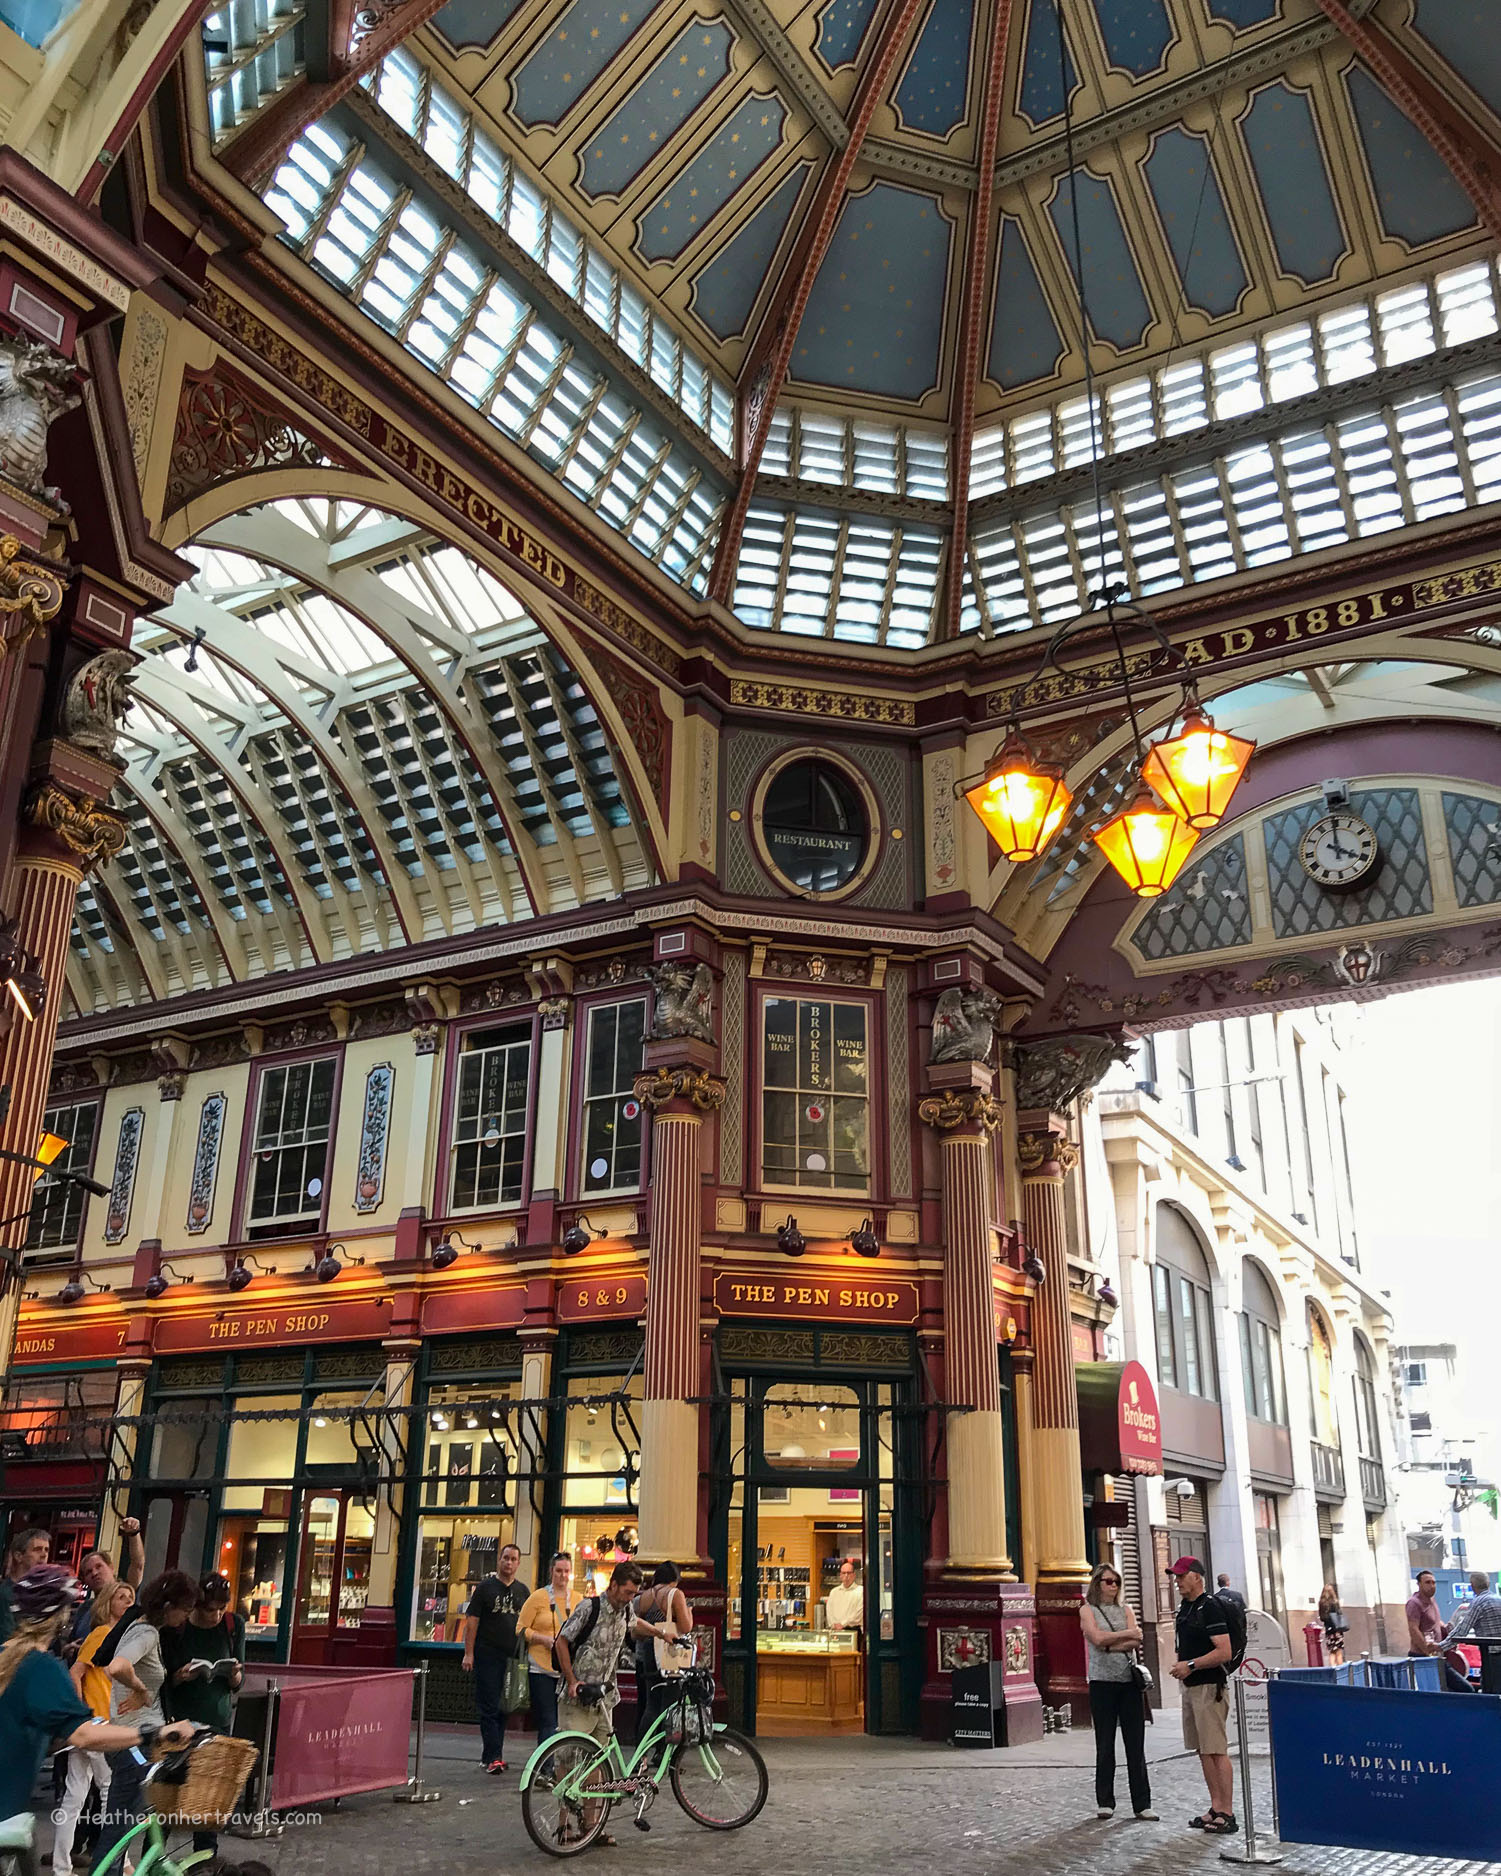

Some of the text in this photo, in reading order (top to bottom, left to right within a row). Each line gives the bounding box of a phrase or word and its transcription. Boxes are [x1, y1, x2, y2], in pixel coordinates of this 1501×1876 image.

[381, 423, 566, 588] ERECTED
[1284, 592, 1388, 641] 1881
[774, 833, 852, 851] RESTAURANT
[768, 1033, 795, 1043] WINE
[771, 1043, 791, 1052] BAR
[810, 1007, 820, 1085] BROKERS
[837, 1039, 863, 1049] WINE
[840, 1049, 860, 1058] BAR
[577, 1287, 628, 1307] 8 & 9
[731, 1284, 900, 1310] THE PEN SHOP
[209, 1314, 330, 1339] THE PEN SHOP
[10, 1331, 126, 1354] ANDAS 7
[1123, 1402, 1156, 1431] Brokers
[964, 1692, 980, 1701] free
[308, 1720, 383, 1744] LEADENHALL
[1323, 1752, 1452, 1776] LEADENHALL
[1351, 1770, 1420, 1785] MARKET
